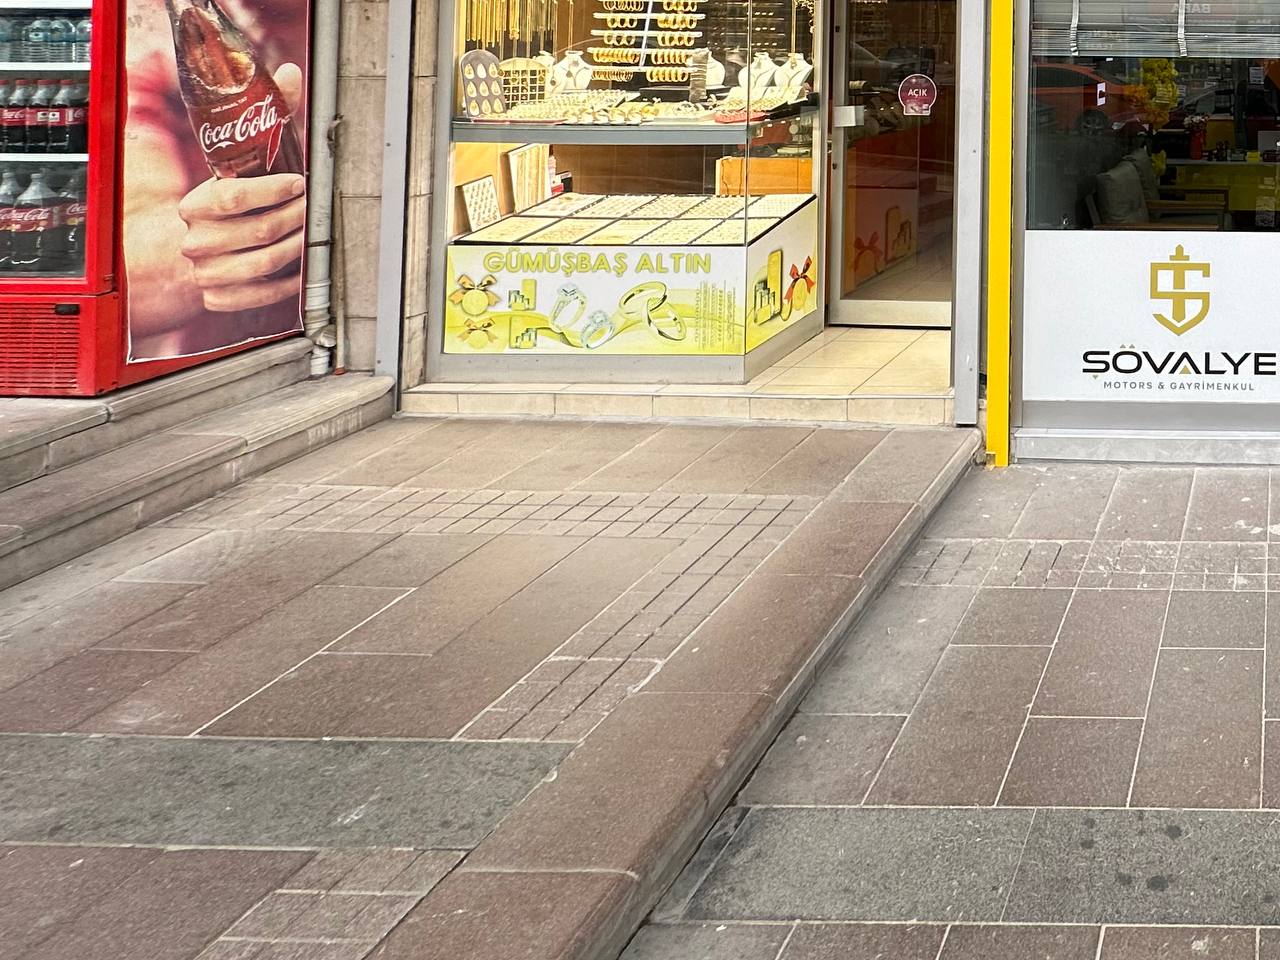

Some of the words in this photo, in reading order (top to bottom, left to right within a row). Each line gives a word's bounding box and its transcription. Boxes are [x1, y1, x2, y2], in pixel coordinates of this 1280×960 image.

[907, 88, 928, 99] AÇIK
[199, 93, 278, 153] Coca-Cola
[483, 247, 629, 278] GÜMÜŞBAŞ
[635, 252, 712, 274] ALTIN
[1082, 343, 1277, 380] ŞÖVALYE
[1103, 381, 1153, 390] MOTORS
[1157, 381, 1165, 390] &
[1170, 380, 1255, 391] GAYRİMENKUL
